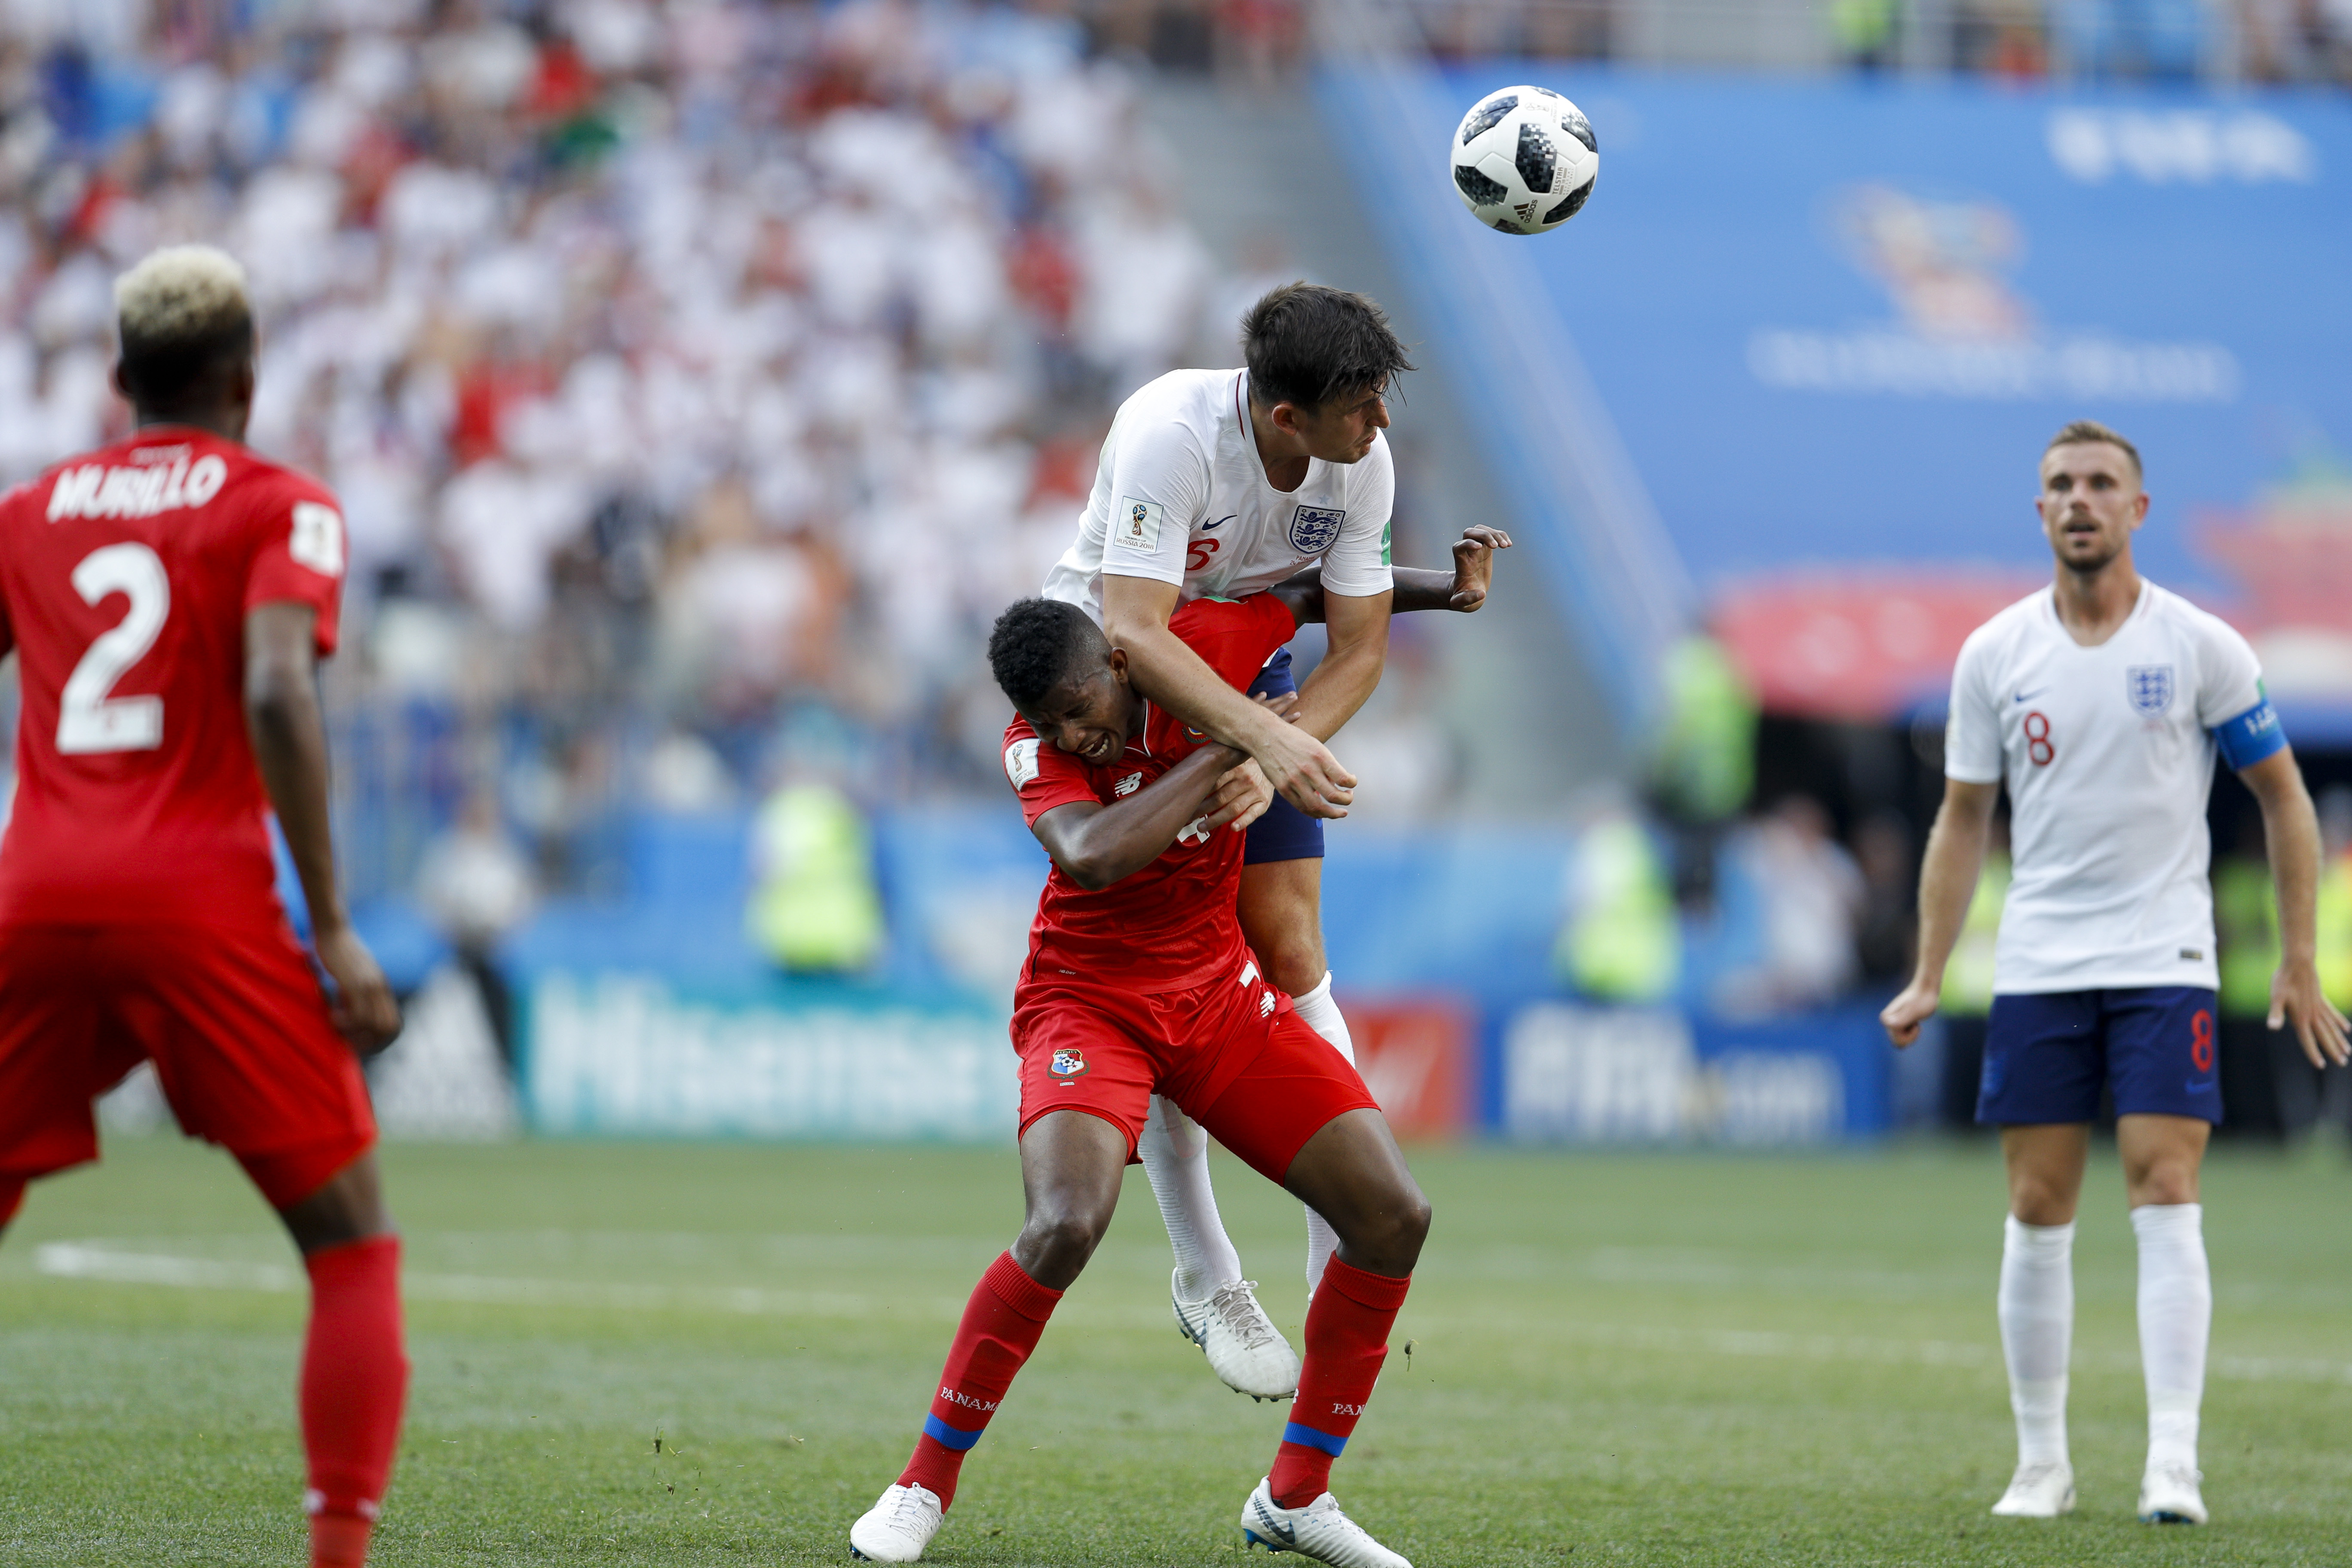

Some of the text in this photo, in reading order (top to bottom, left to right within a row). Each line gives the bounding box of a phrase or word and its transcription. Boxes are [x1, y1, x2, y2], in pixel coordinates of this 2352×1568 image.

[1553, 167, 1563, 194] TELSTAR
[1524, 199, 1538, 223] adidas
[45, 454, 228, 523] MURILLO
[1116, 537, 1139, 547] RUSSIA
[55, 541, 171, 755] 2
[2024, 711, 2054, 766] 8
[2191, 1009, 2213, 1073] 8
[1332, 1403, 1366, 1415] PAN
